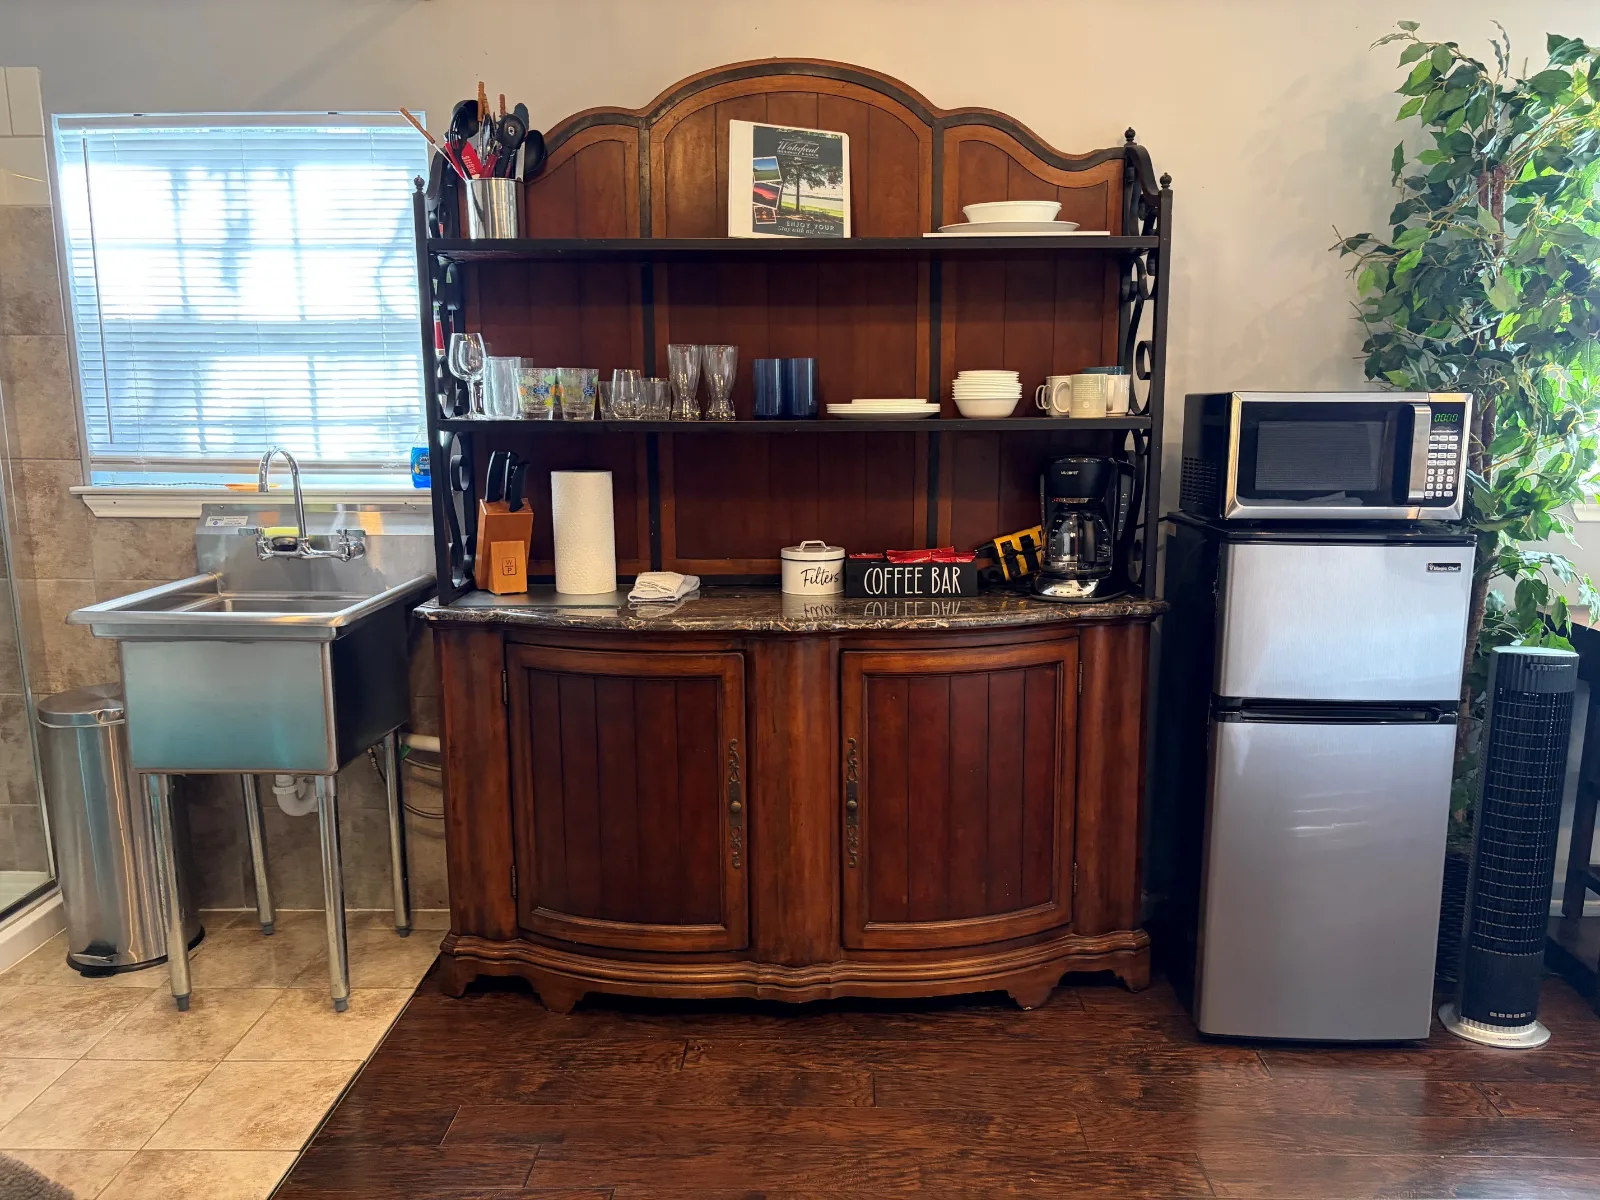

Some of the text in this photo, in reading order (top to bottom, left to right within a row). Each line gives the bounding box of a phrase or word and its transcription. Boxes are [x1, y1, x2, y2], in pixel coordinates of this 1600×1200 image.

[777, 141, 819, 155] Waterfront
[786, 221, 835, 231] ENJOY YOUR
[800, 566, 840, 588] Filters
[864, 566, 962, 595] COFFEE BAR
